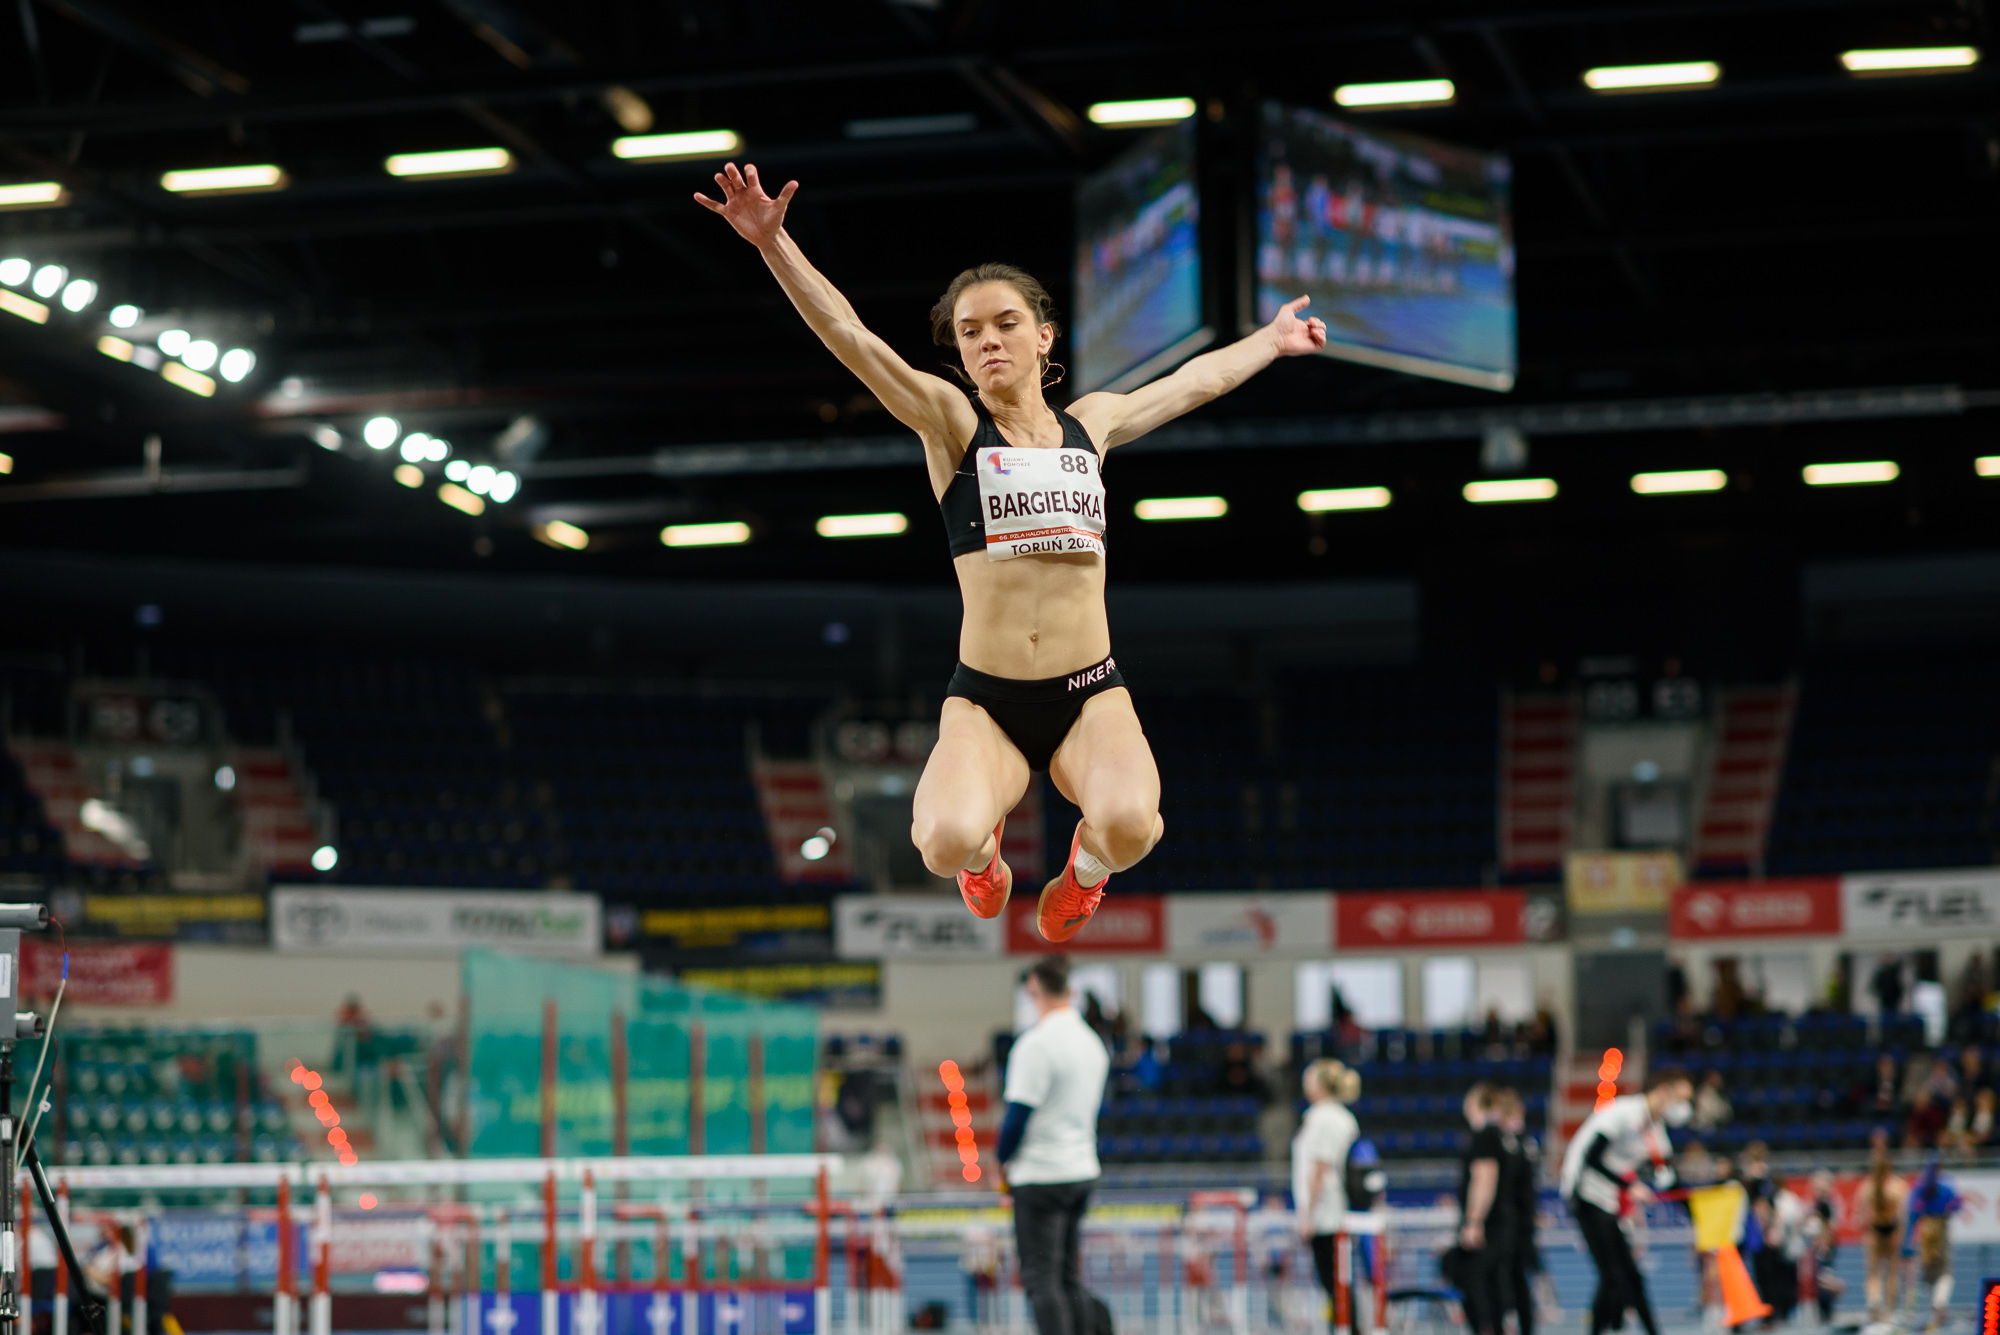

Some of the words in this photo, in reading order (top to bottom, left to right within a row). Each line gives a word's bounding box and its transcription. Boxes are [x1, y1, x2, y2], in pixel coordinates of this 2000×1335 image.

[1059, 454, 1089, 475] 88
[988, 490, 1102, 520] BARGIELSKA
[1026, 529, 1050, 538] HALOWE
[1011, 536, 1062, 556] TORUŃ
[1068, 664, 1106, 692] NIKE
